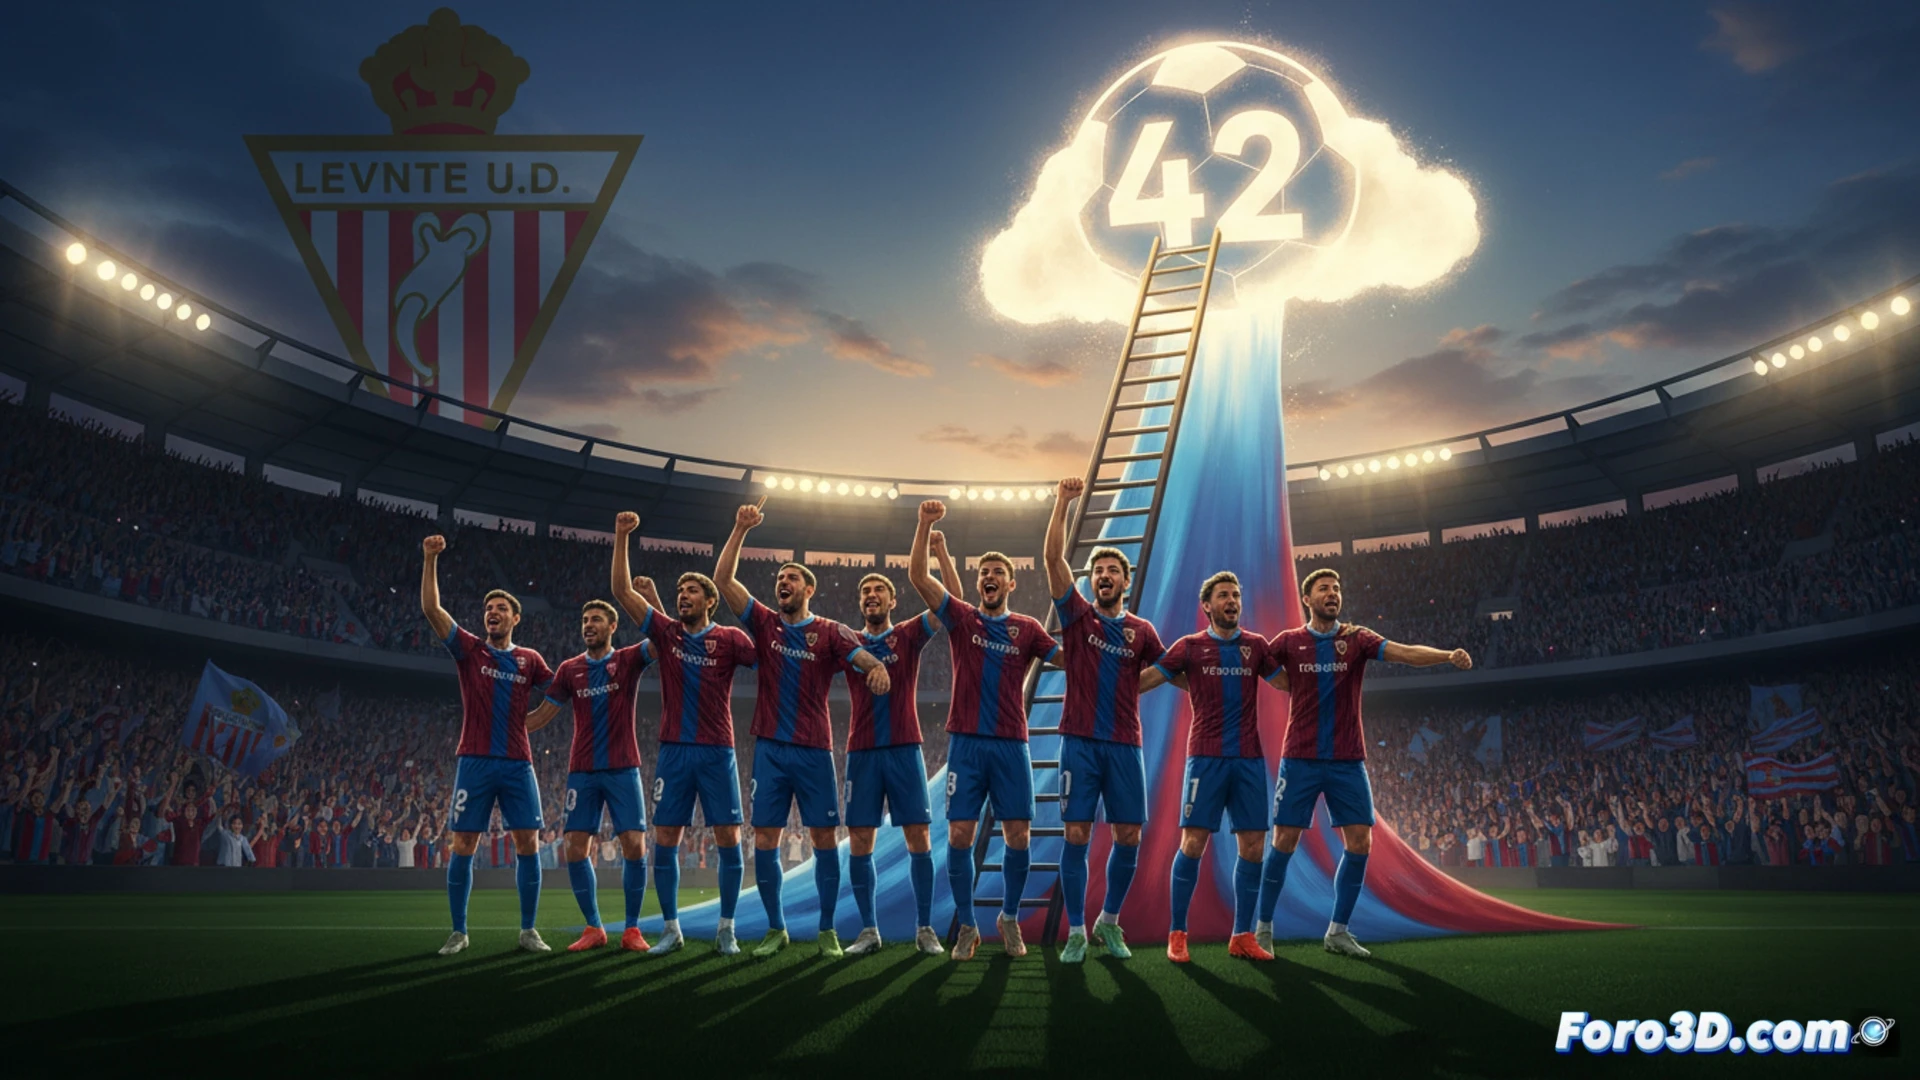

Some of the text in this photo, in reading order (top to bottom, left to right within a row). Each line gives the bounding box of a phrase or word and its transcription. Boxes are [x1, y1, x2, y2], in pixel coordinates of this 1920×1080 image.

[295, 162, 570, 194] LEVNTE U.D.
[1108, 110, 1303, 248] 42
[455, 789, 468, 811] 2
